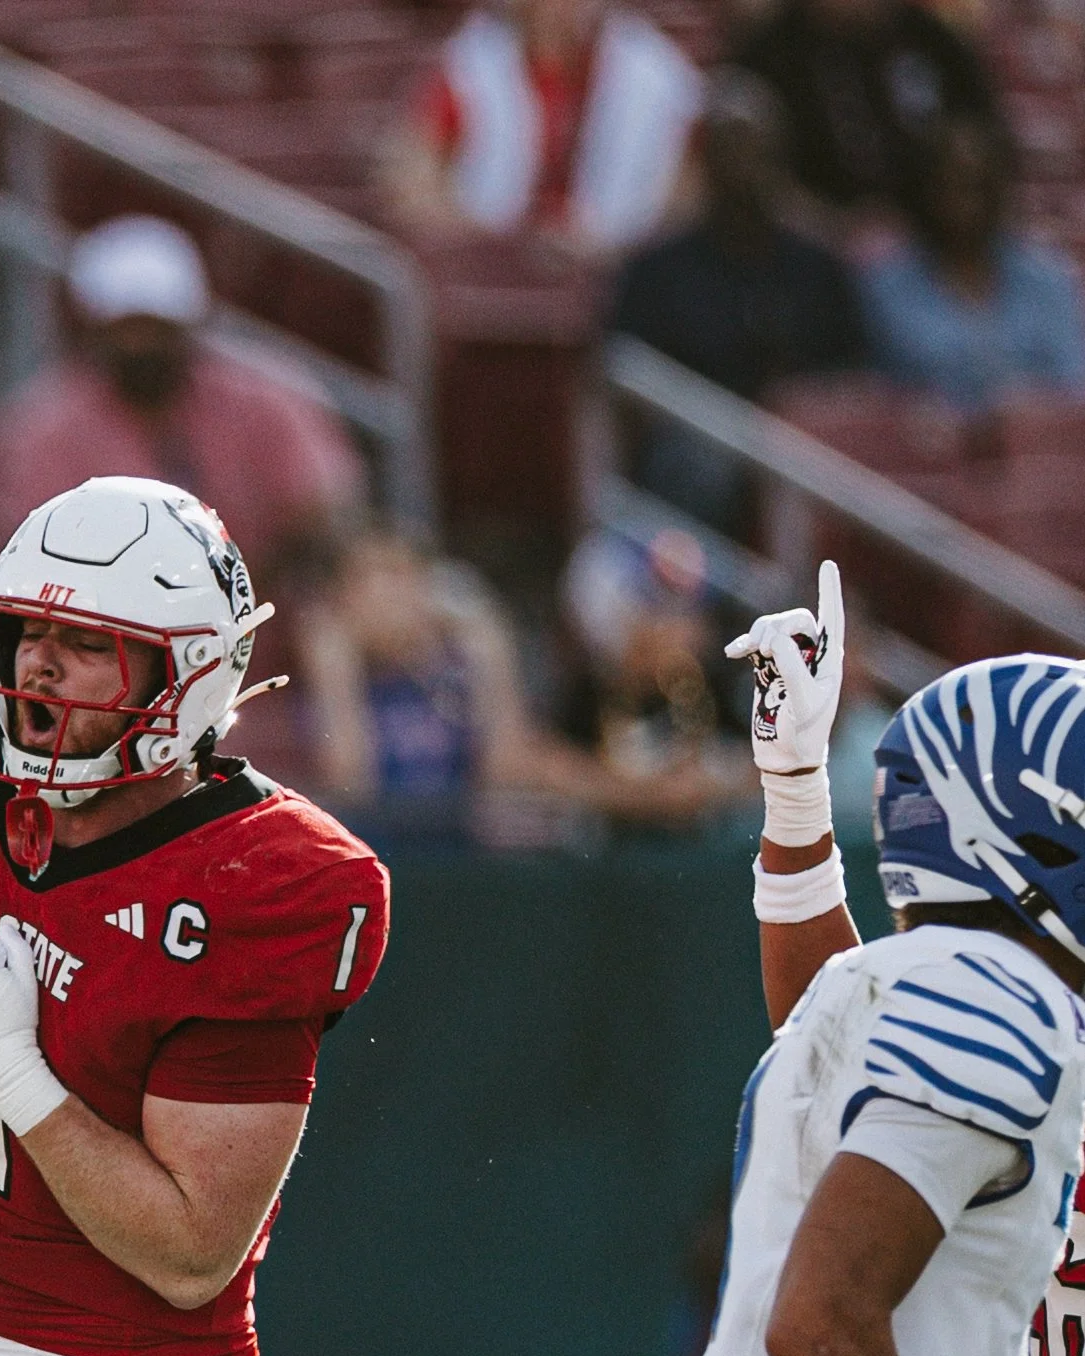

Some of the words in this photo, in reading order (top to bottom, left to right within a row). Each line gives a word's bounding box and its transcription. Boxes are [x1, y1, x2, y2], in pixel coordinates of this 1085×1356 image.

[39, 582, 76, 604] HTT
[22, 761, 65, 778] Riddll
[163, 900, 208, 962] C
[334, 906, 368, 991] 1
